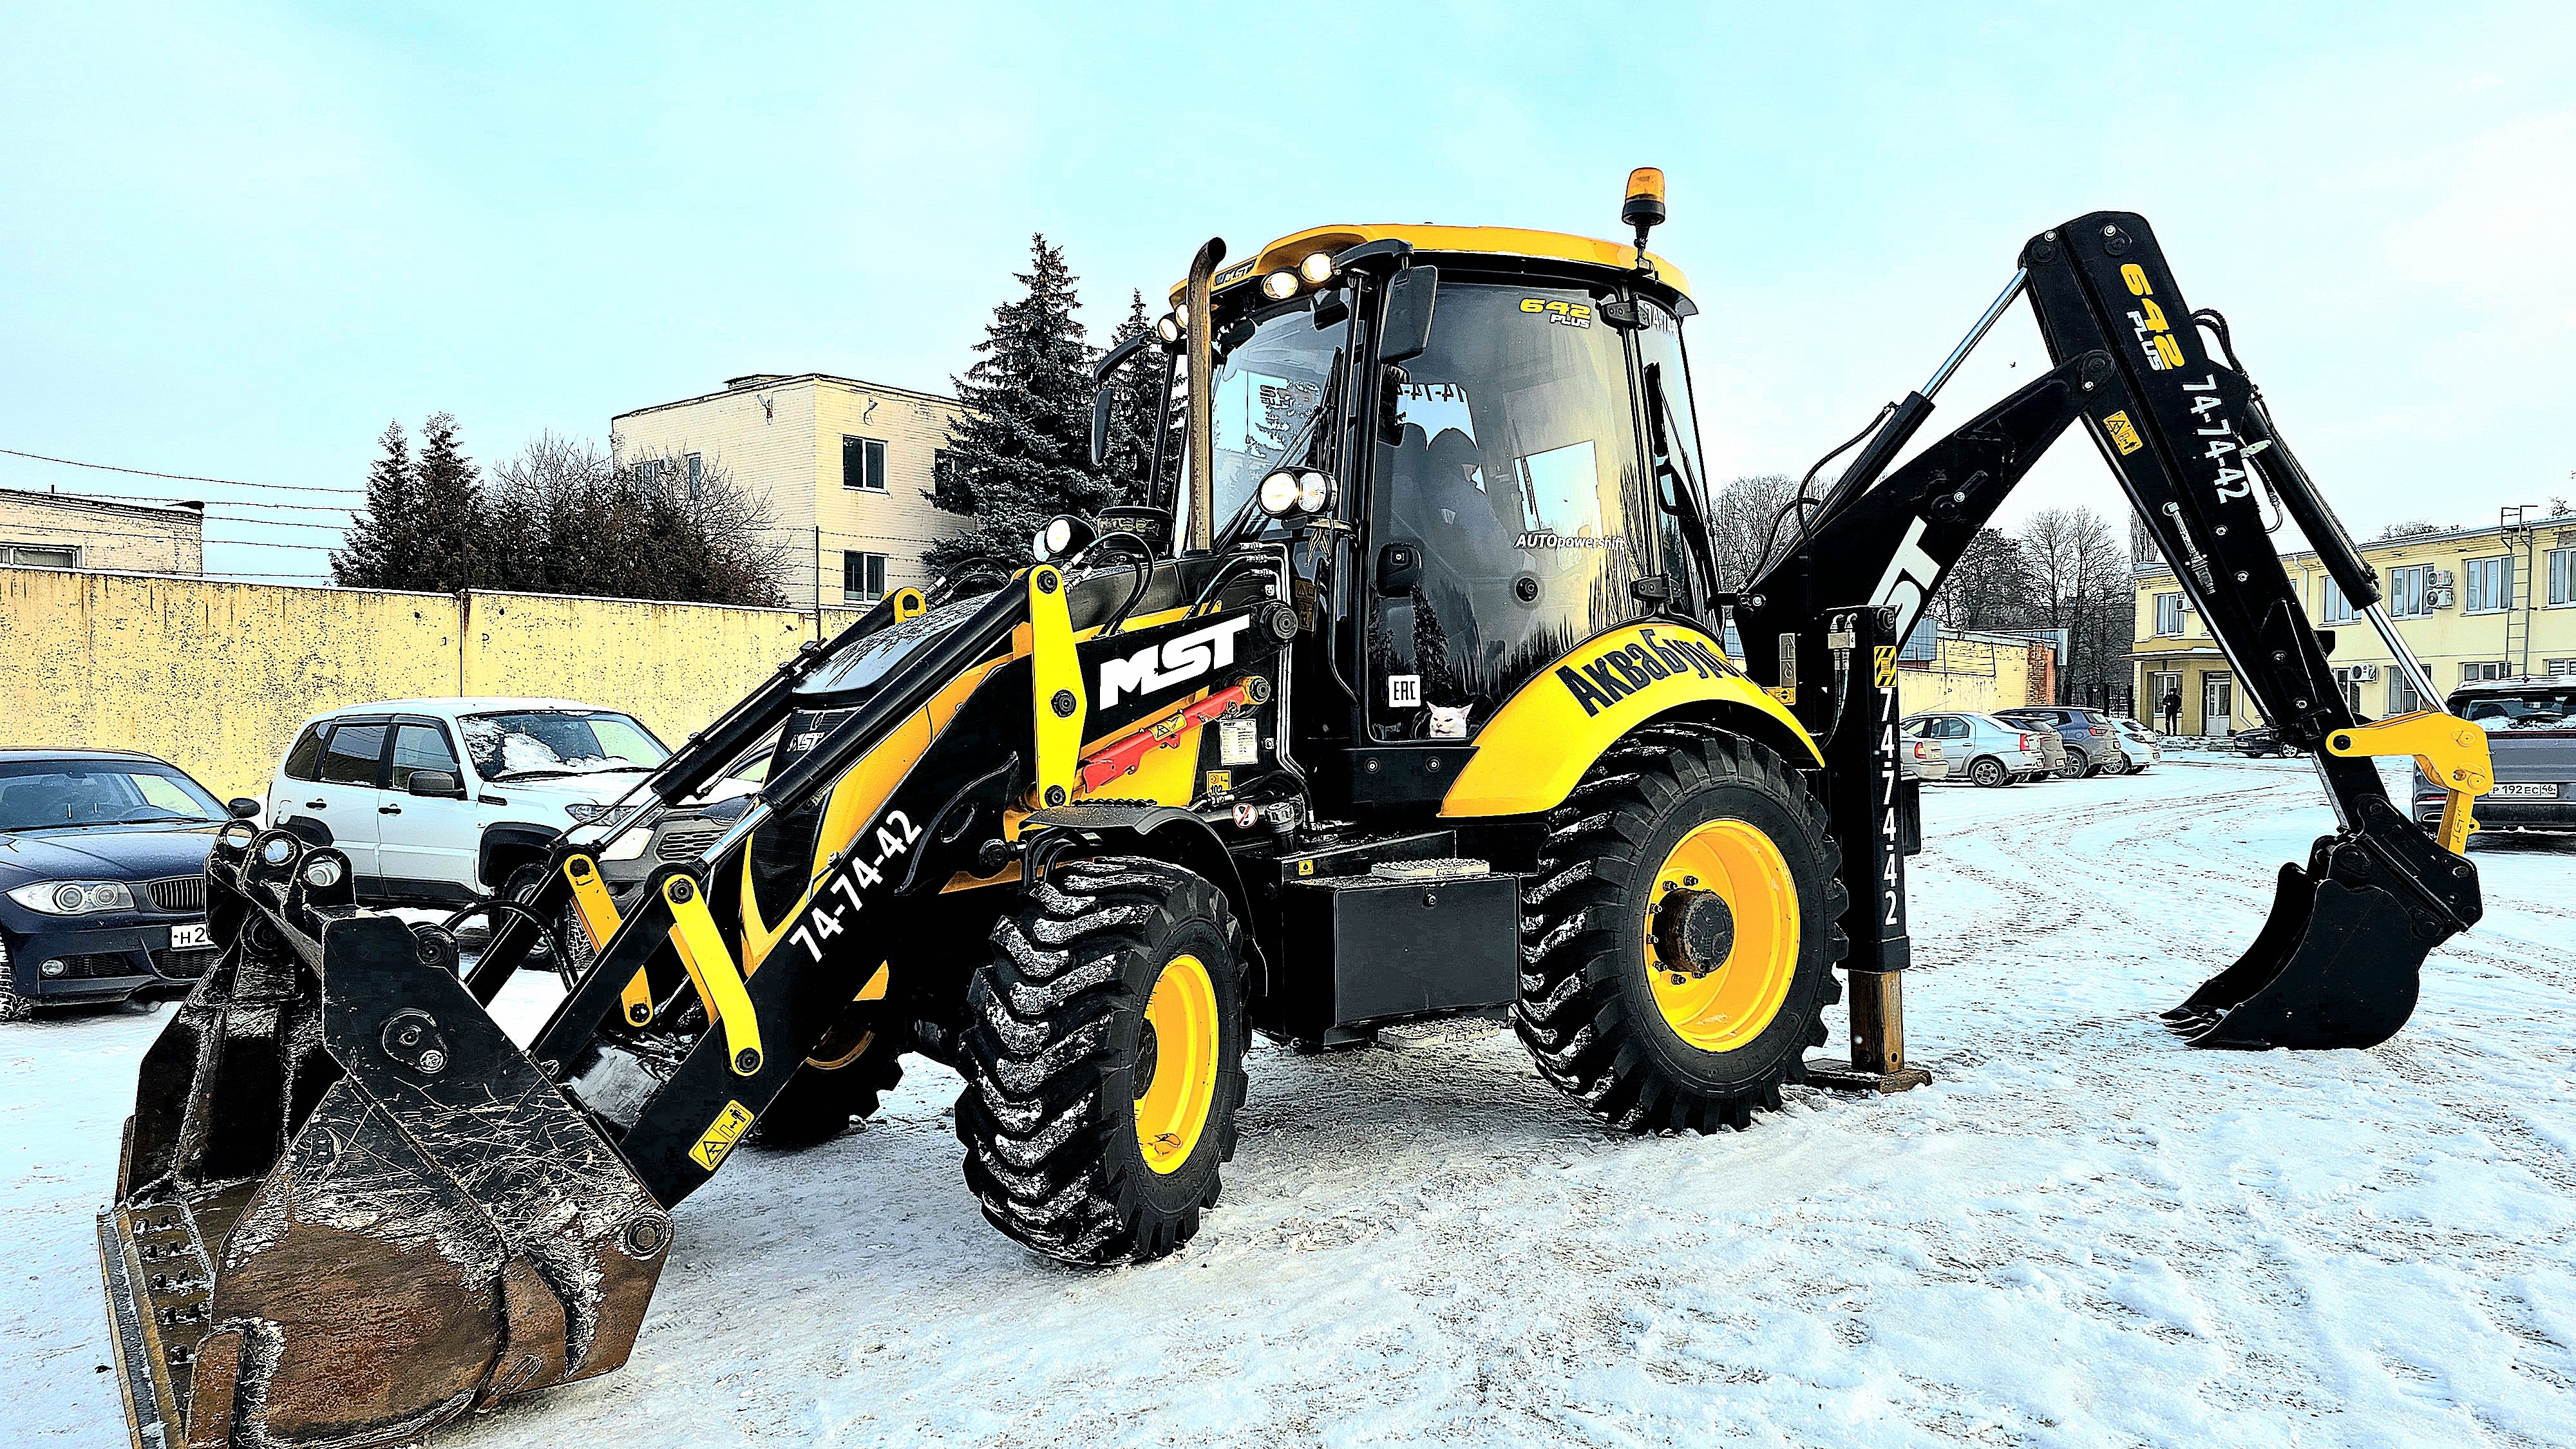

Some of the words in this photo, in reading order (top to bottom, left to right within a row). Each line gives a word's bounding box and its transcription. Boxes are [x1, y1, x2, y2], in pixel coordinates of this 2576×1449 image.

[1520, 299, 1591, 319] 642
[1550, 314, 1590, 328] PLUS
[2121, 263, 2185, 370] 642
[2127, 311, 2165, 371] PLUS
[2183, 375, 2251, 504] 74-74-42
[1514, 533, 1625, 552] AUTOpowershift
[1099, 615, 1250, 710] MST
[1394, 681, 1416, 700] EAC
[1879, 687, 1898, 925] 74-74-42
[789, 810, 922, 962] 74-74-42
